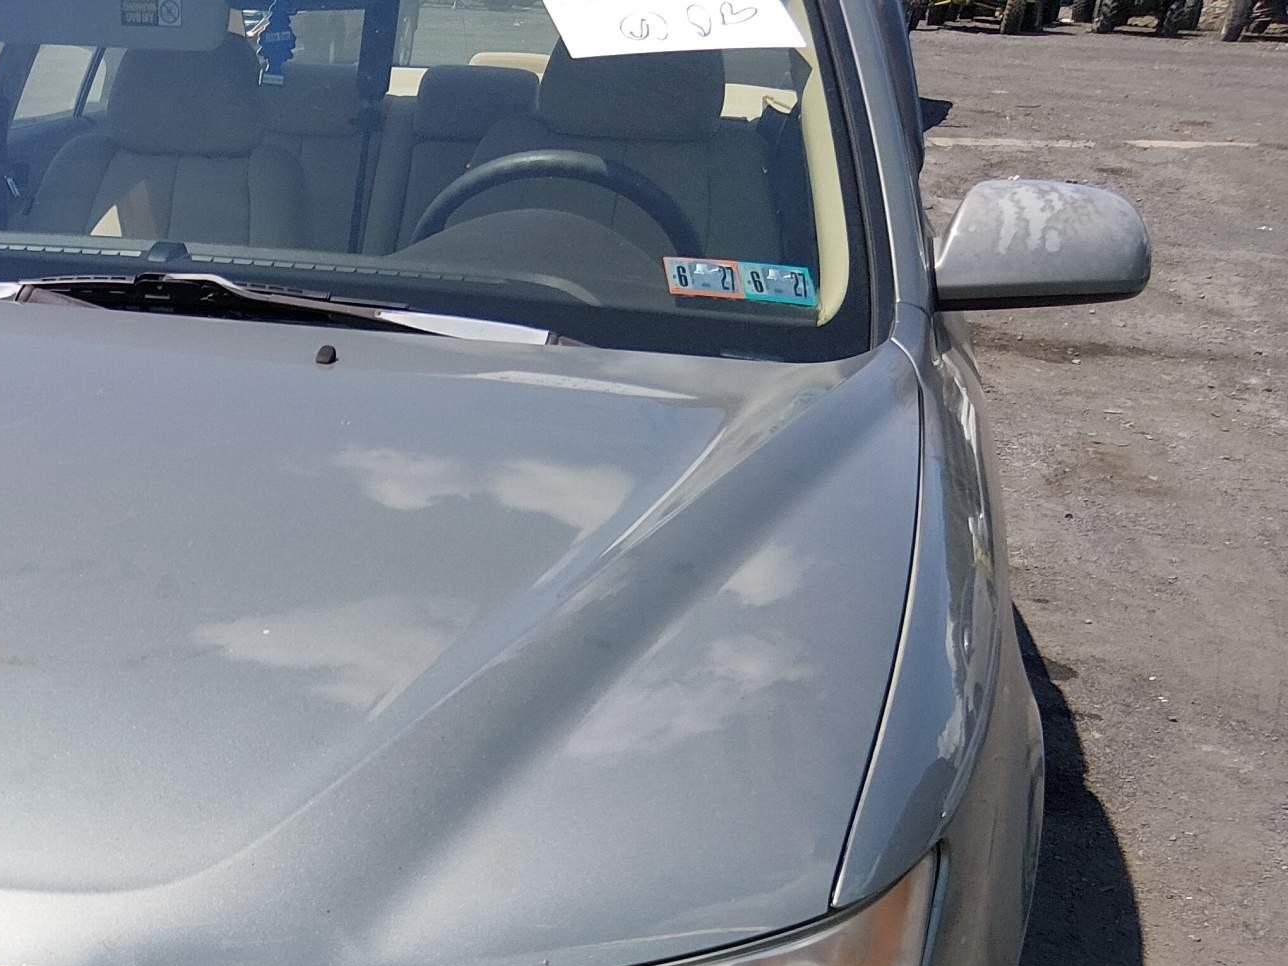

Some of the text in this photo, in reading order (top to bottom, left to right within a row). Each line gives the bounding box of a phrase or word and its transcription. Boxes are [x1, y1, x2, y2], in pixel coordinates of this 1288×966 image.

[676, 265, 736, 292] 6 27
[750, 270, 808, 299] 6 27
